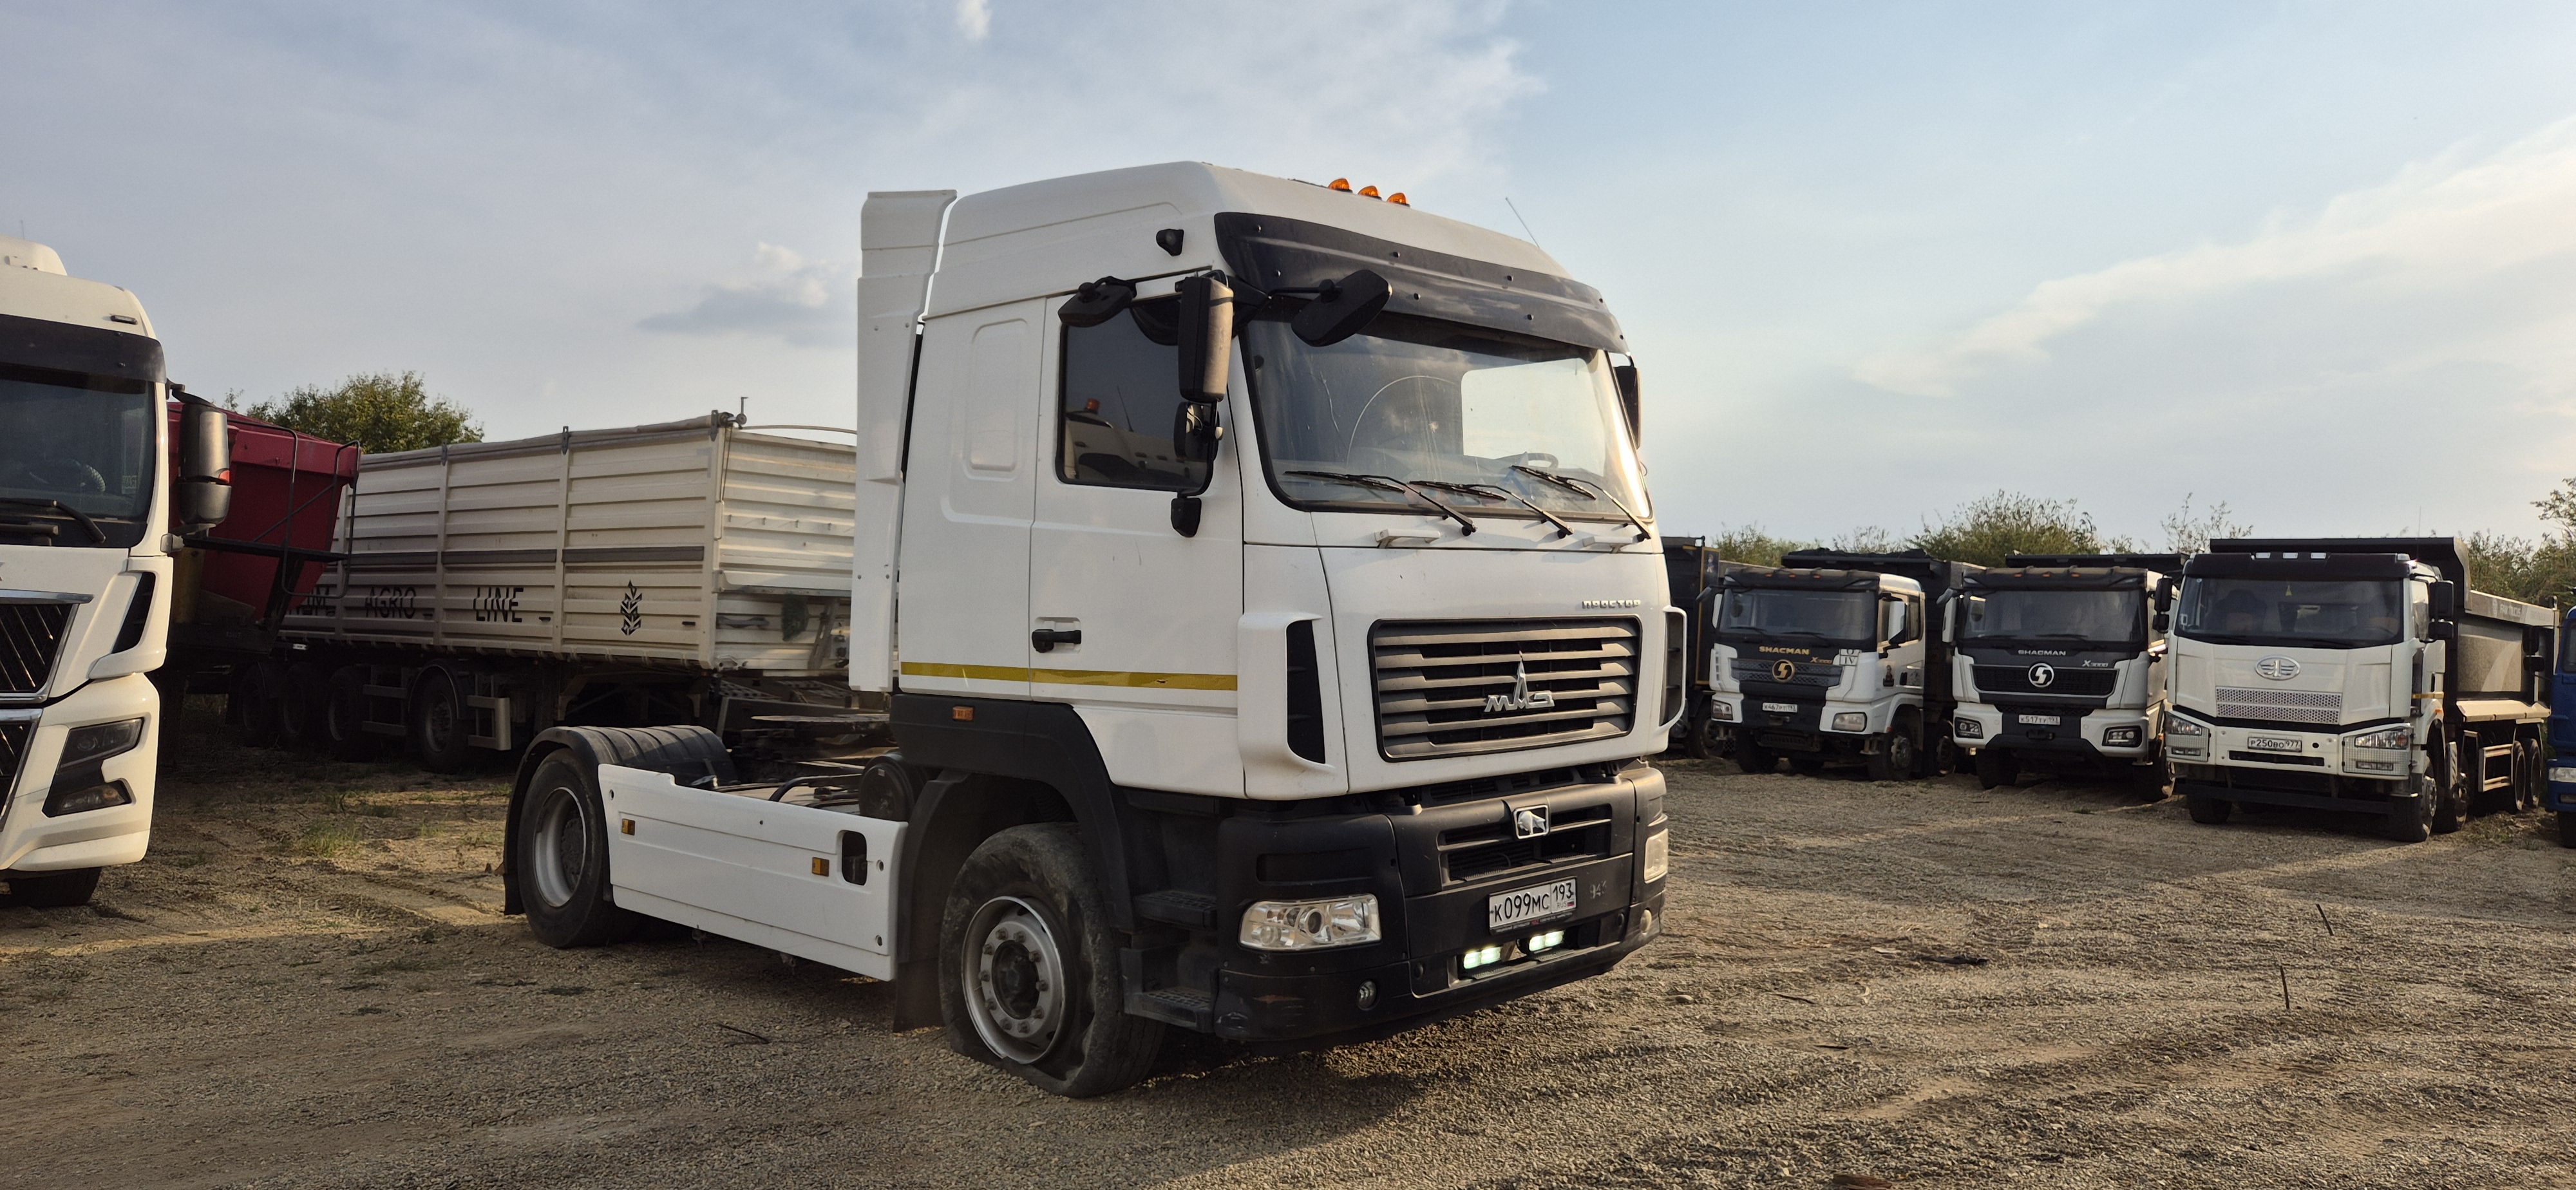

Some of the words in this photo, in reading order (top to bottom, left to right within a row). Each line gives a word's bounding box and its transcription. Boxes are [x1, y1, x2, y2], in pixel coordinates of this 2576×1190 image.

[365, 586, 416, 618] AGRO
[473, 587, 524, 623] LINE
[1582, 600, 1641, 609] ПРОСТОР
[1759, 646, 1810, 655] SHACMAN
[1494, 891, 1549, 923] К099МС
[1552, 882, 1573, 902] 193
